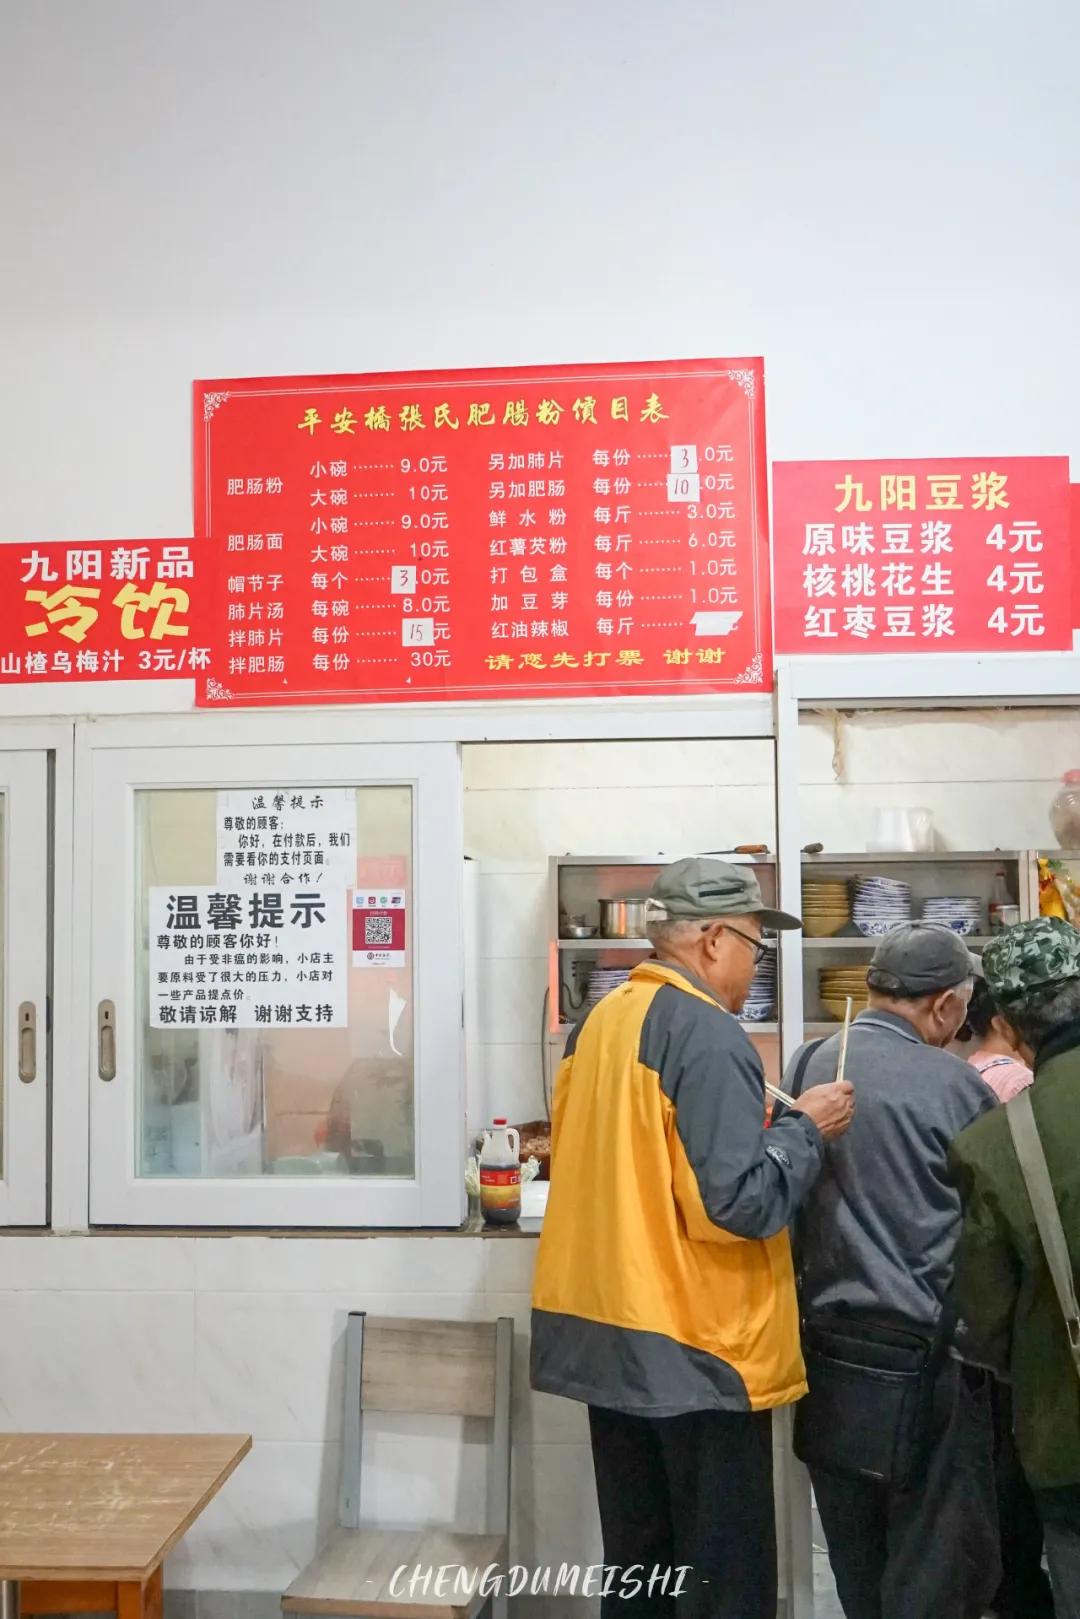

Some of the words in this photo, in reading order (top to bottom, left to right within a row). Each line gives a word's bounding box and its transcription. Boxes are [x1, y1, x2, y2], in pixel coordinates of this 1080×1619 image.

[309, 460, 348, 477] 小碗
[401, 456, 447, 473] 9.0元
[488, 452, 564, 470] 另加肺片
[593, 449, 631, 467] 每份
[227, 477, 283, 496] 肥肠粉
[310, 489, 348, 506] 大碗
[409, 484, 448, 501] 10元
[489, 480, 566, 499] 另加肥肠
[593, 477, 631, 495] 每份
[834, 471, 1010, 512] 九阳豆浆
[310, 516, 348, 534] 小碗
[401, 512, 449, 529] 9.0元
[489, 507, 567, 527] 鲜水粉
[594, 505, 631, 524] 每斤
[688, 503, 735, 520] 3.0元
[228, 533, 284, 552] 肥肠面
[490, 537, 567, 557] 红薯芡粉
[594, 534, 632, 552] 每斤
[689, 531, 736, 549] 6.0元
[802, 520, 954, 555] 原味豆浆
[986, 521, 1044, 553] 4元
[311, 545, 349, 563] 大碗
[410, 541, 449, 558] 10元
[20, 546, 194, 583] 九阳新品
[490, 564, 568, 584] 打包盒
[595, 561, 633, 580] 每个
[689, 560, 737, 577] 1.0元
[228, 574, 284, 593] 帽节子
[311, 572, 349, 590] 每个
[803, 562, 955, 597] 核桃花生
[987, 563, 1044, 595] 4元
[228, 601, 284, 620] 肺片汤
[312, 599, 349, 617] 每碗
[402, 597, 450, 614] 8.0元
[491, 592, 568, 611] 加豆芽
[596, 589, 634, 608] 每份
[690, 587, 737, 604] 1.0元
[25, 582, 190, 643] 冷饮
[804, 603, 956, 639] 红枣豆浆
[987, 605, 1045, 636] 4元
[228, 628, 284, 648] 拌肺片
[312, 626, 349, 644] 每份
[492, 619, 569, 639] 红油辣椒
[596, 616, 634, 635] 每斤
[1, 649, 124, 674] 山楂乌梅汁
[138, 647, 211, 671] 3元/杯
[229, 655, 285, 674] 拌肥肠
[312, 653, 350, 671] 每份
[411, 650, 451, 667] 30元
[485, 650, 644, 671] 请您先打票
[663, 648, 725, 664] 谢谢
[252, 795, 324, 811] 温馨提示
[166, 893, 326, 930] 温馨提示
[159, 1005, 238, 1024] 敬请谅解
[254, 1004, 333, 1023] 谢谢支持
